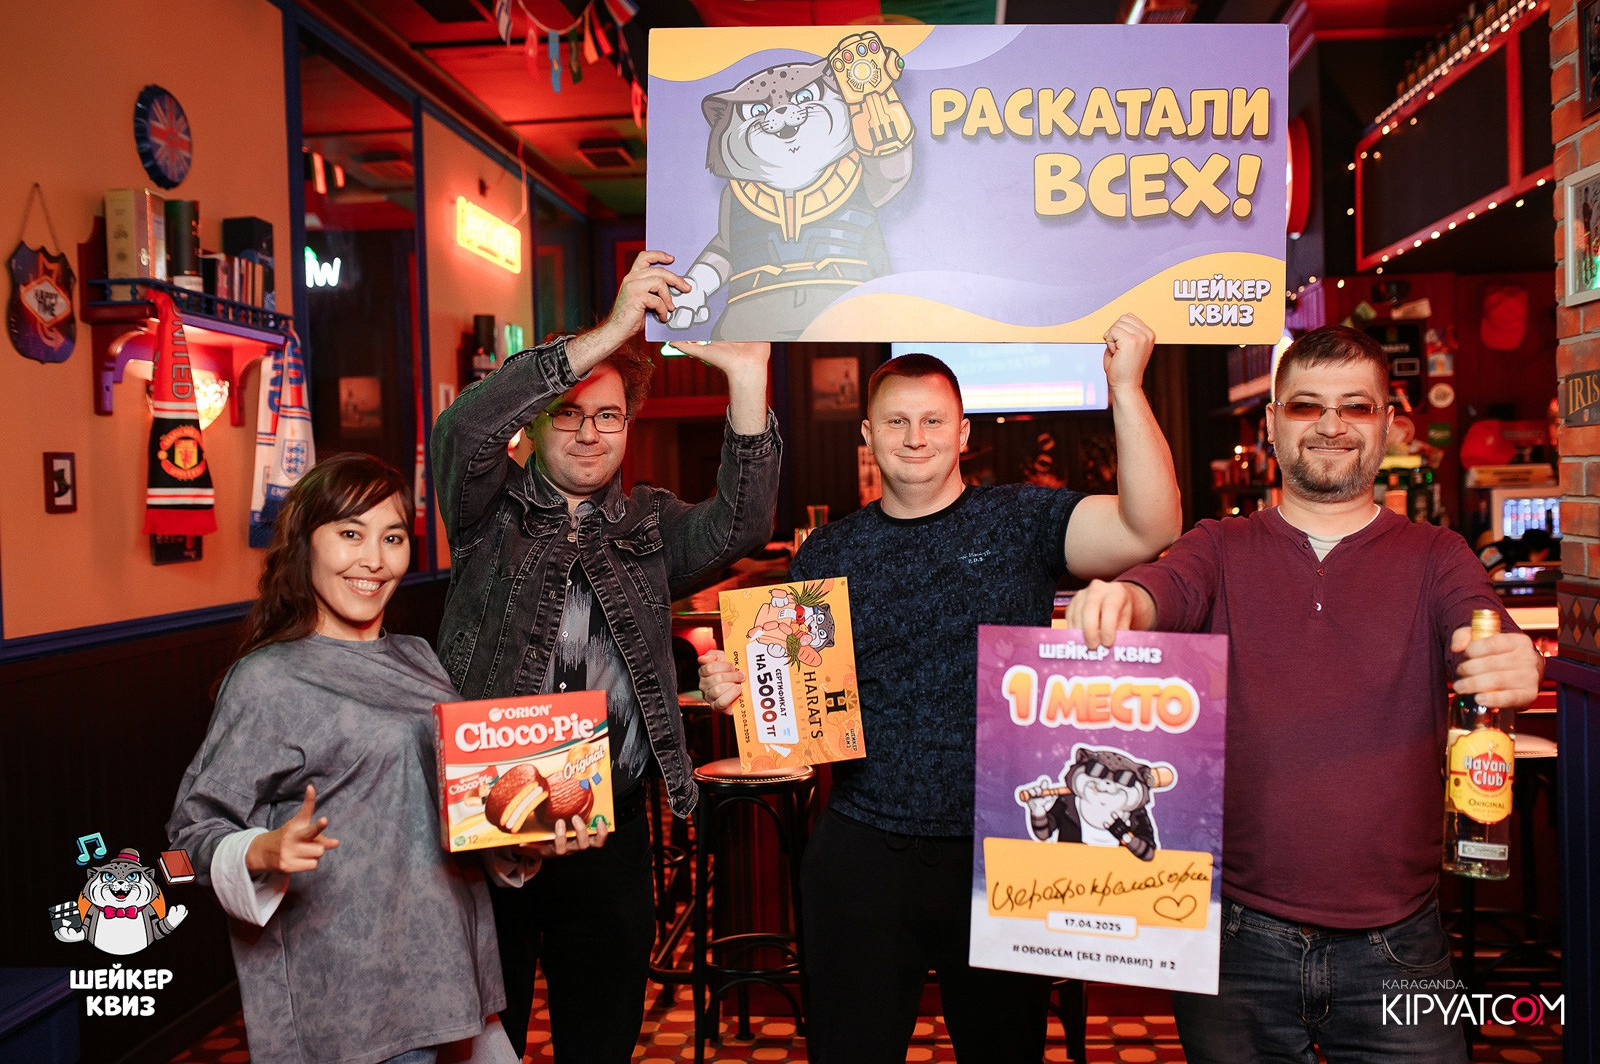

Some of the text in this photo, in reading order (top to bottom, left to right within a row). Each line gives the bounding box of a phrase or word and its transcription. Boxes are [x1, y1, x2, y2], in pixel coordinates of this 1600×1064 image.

[930, 86, 1270, 139] РАСКАТАЛИ
[1033, 152, 1263, 221] ВСЕХ!
[1173, 274, 1271, 301] ШЕЙКЕР
[1188, 303, 1255, 327] КВИЗ
[1039, 640, 1162, 664] ШЕЙКЕР КВИЗ
[756, 653, 777, 737] НА 5000 ТГ
[775, 668, 787, 717] СЕРТИФИКАТ
[1004, 667, 1197, 731] 1 МЕСТО
[504, 704, 550, 720] ORION
[563, 745, 605, 781] Original
[1473, 770, 1503, 787] Club
[1065, 918, 1121, 932] 17.04.2025
